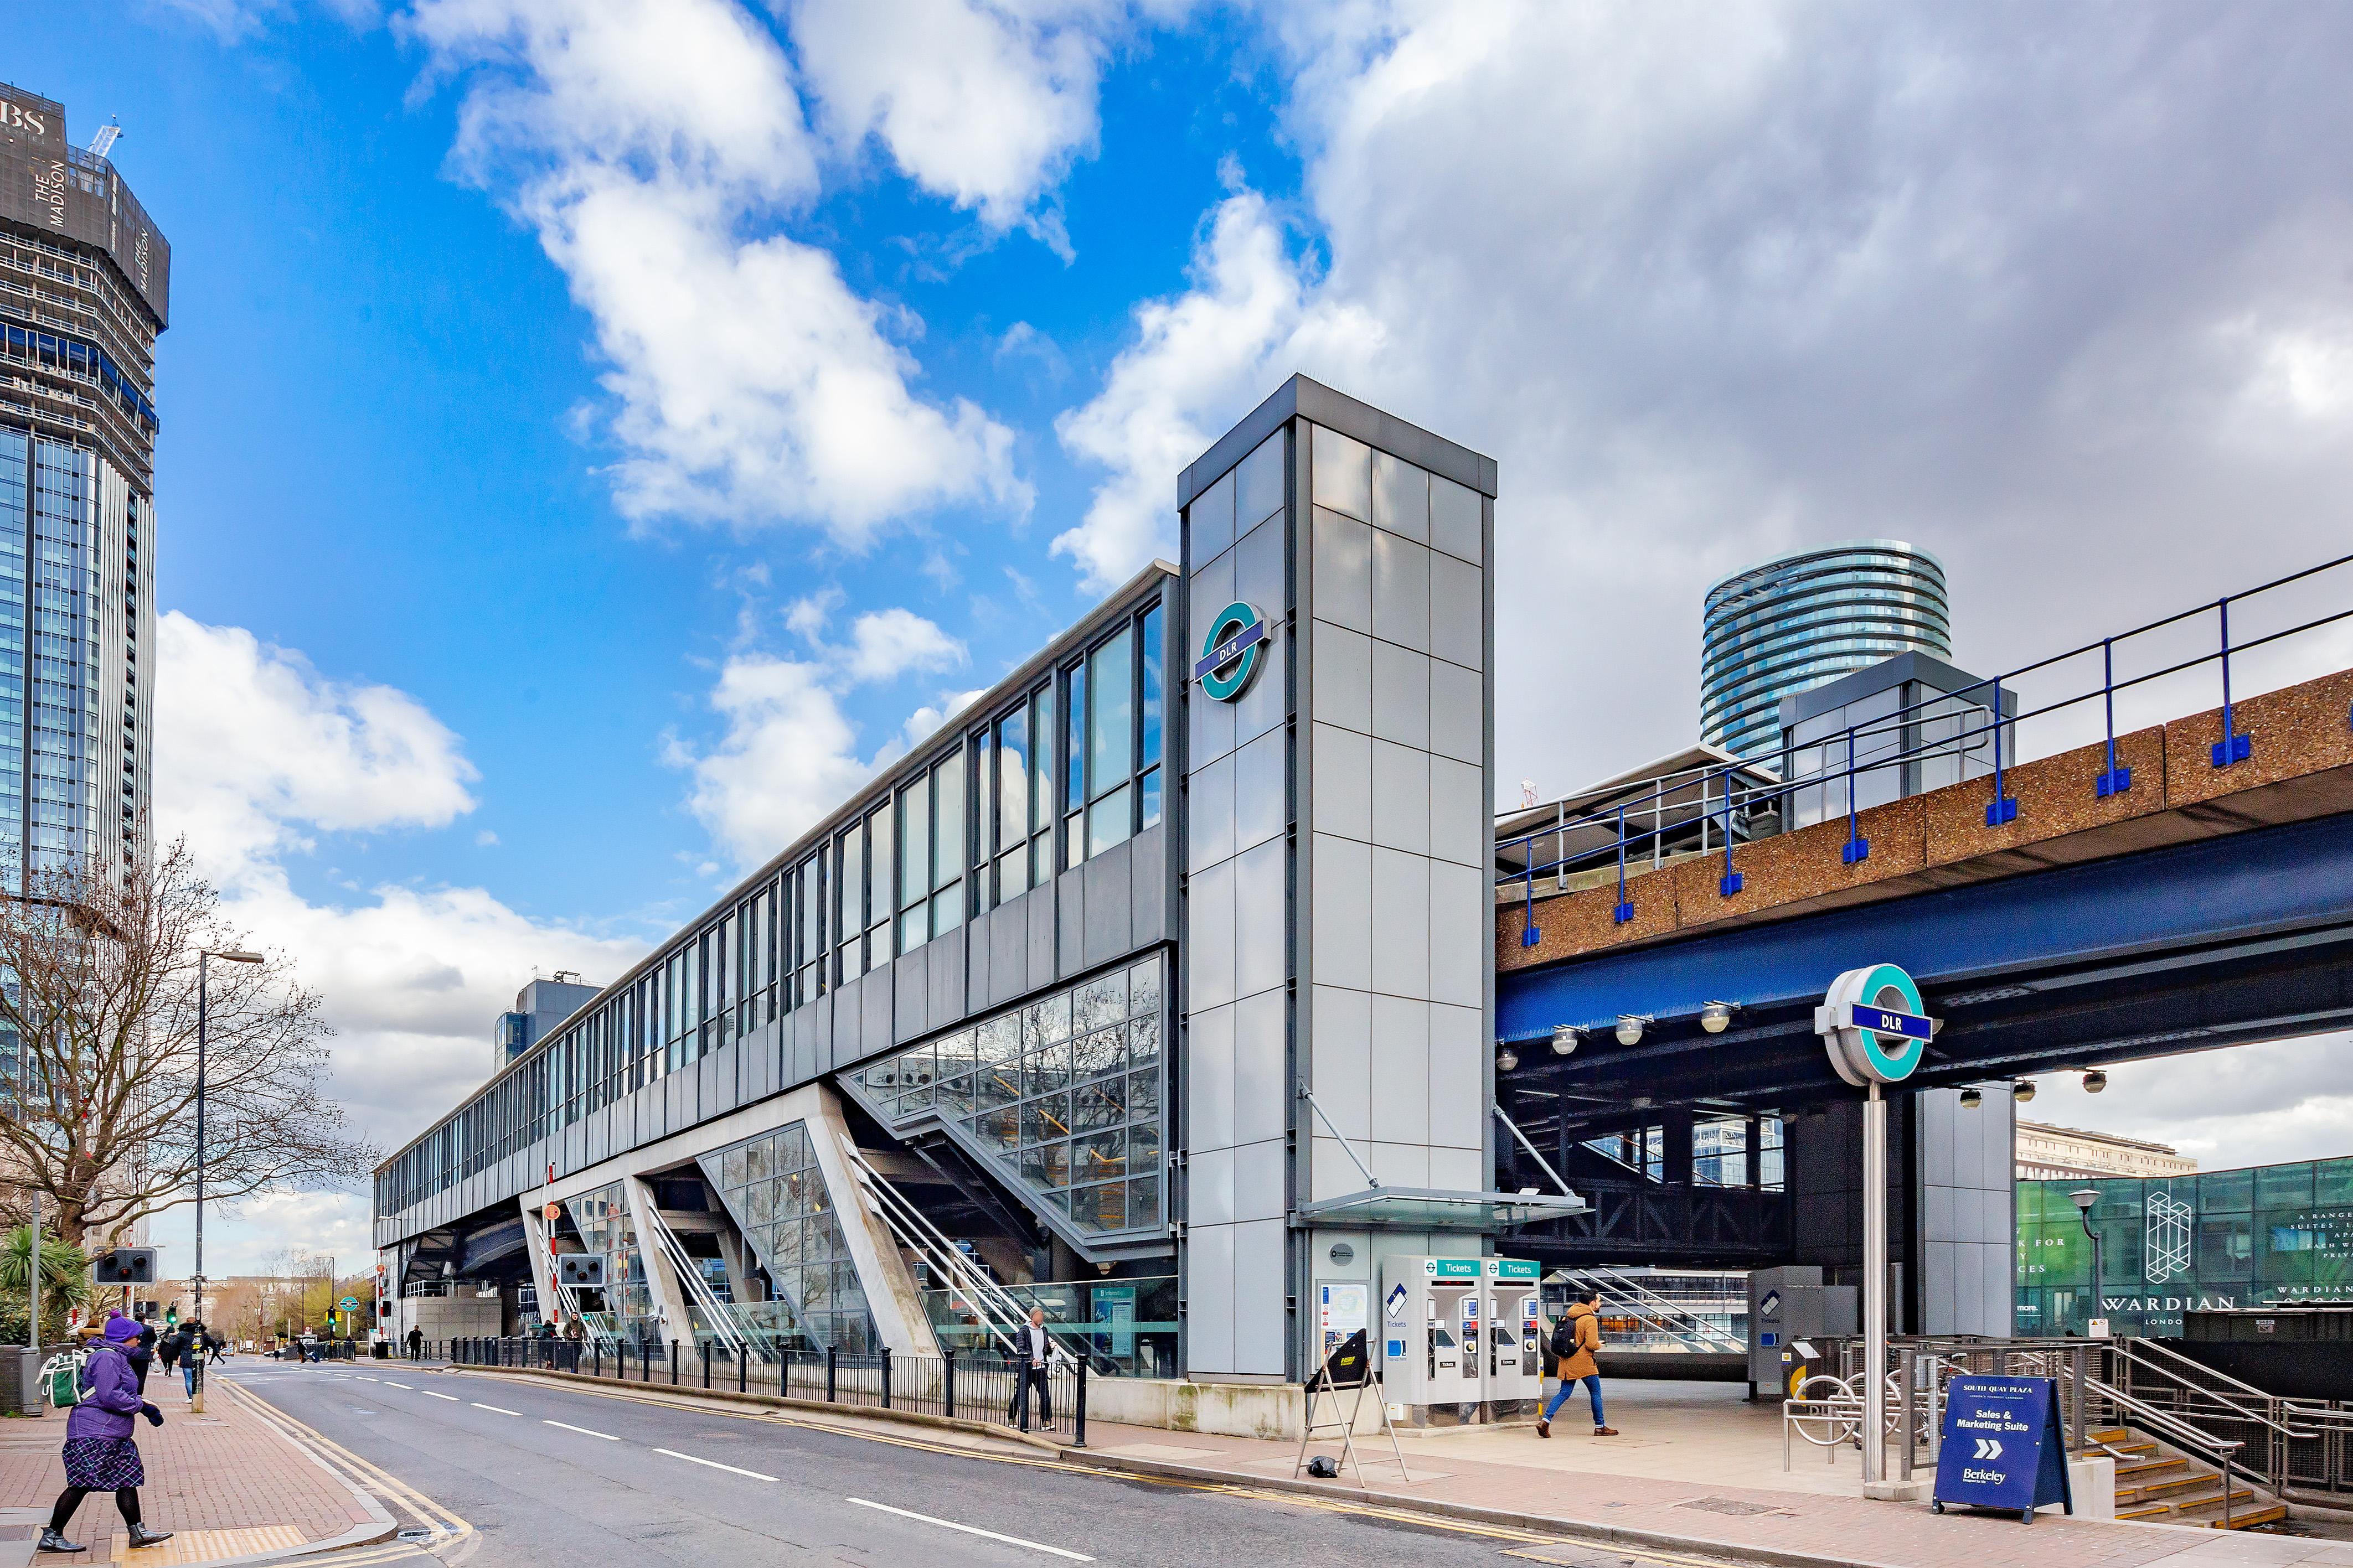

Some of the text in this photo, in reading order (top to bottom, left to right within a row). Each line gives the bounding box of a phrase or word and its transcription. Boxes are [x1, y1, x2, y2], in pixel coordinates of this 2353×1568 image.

[35, 174, 50, 202] THE
[50, 160, 65, 227] MADISON
[1219, 642, 1237, 661] DLR
[1881, 1014, 1902, 1031] DLR
[2035, 1238, 2065, 1246] FOR
[1446, 1264, 1472, 1272] Tickets
[1507, 1265, 1531, 1274] Tickets
[2102, 1297, 2235, 1311] WARDIAN
[1976, 1410, 2011, 1420] Sales &
[1957, 1419, 2029, 1431] Marketing Suite
[1963, 1468, 2006, 1485] Berkeley
